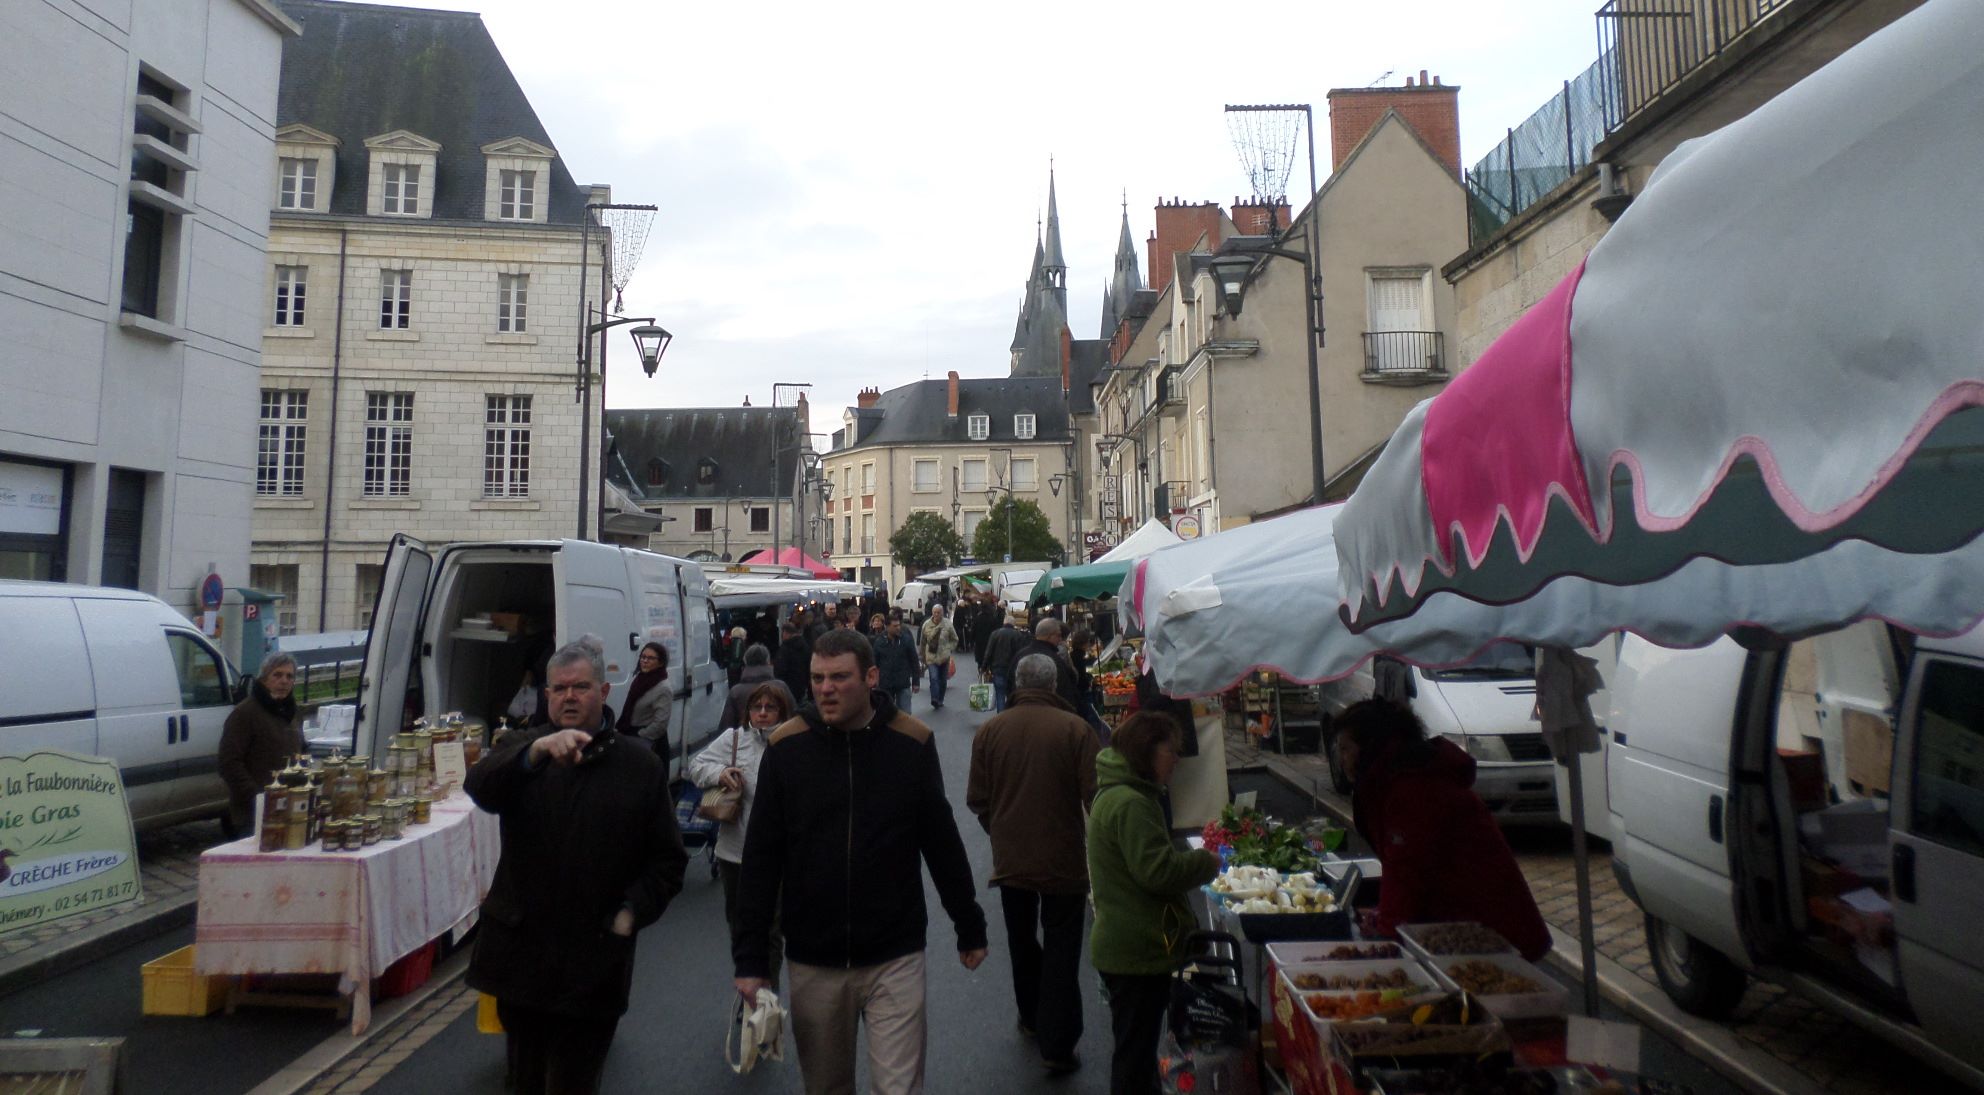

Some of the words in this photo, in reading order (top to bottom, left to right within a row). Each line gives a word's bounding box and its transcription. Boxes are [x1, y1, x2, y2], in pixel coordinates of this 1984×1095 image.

[1105, 478, 1117, 546] RESTO
[246, 605, 257, 619] P
[7, 776, 22, 796] la
[27, 772, 116, 795] Faubonnière
[31, 804, 80, 825] Gras
[76, 853, 118, 873] Frères
[0, 904, 46, 923] hémery
[55, 896, 70, 912] 02
[74, 891, 88, 906] 54
[91, 887, 103, 901] 71
[107, 884, 119, 898] 81
[122, 881, 133, 894] 77
